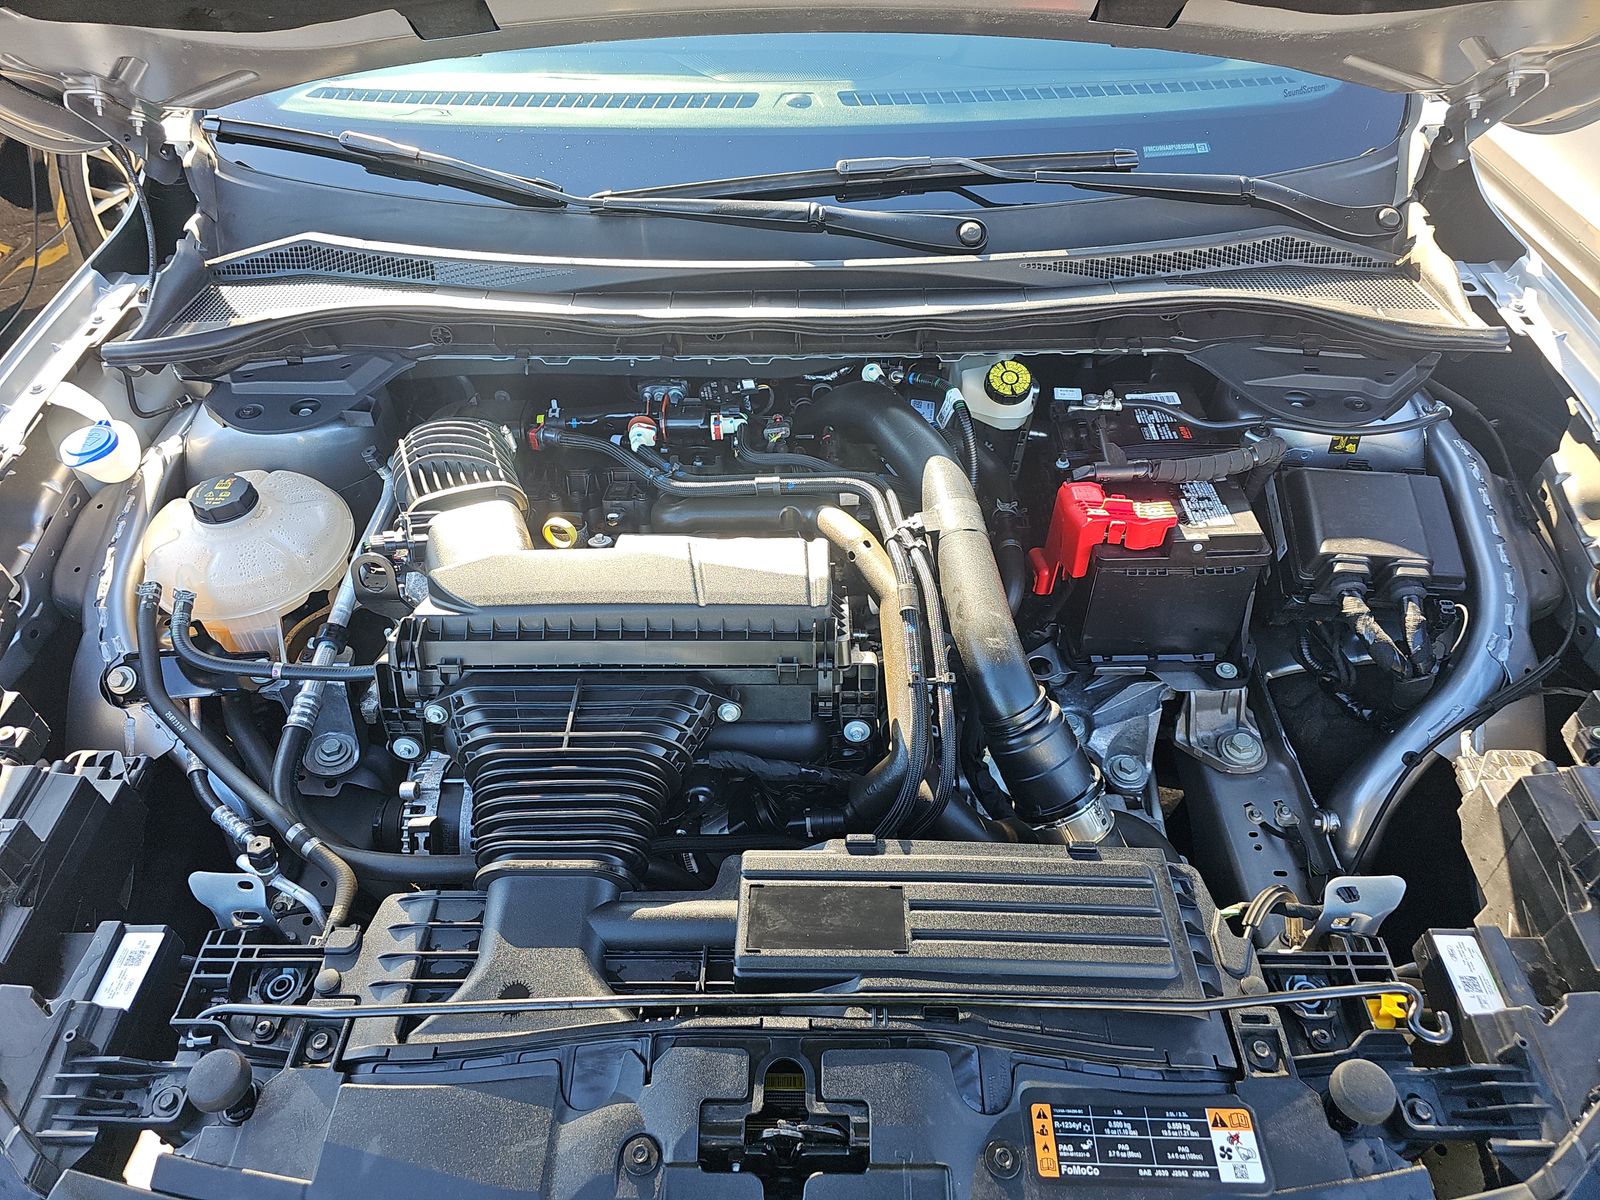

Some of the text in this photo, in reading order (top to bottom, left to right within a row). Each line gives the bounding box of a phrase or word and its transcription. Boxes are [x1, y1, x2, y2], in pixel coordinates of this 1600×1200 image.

[1283, 85, 1326, 98] SoundScreen
[1054, 1122, 1082, 1130] R-1234yf
[1124, 1122, 1132, 1130] kg
[1182, 1122, 1190, 1130] kg
[1062, 1166, 1100, 1176] FoMoCo
